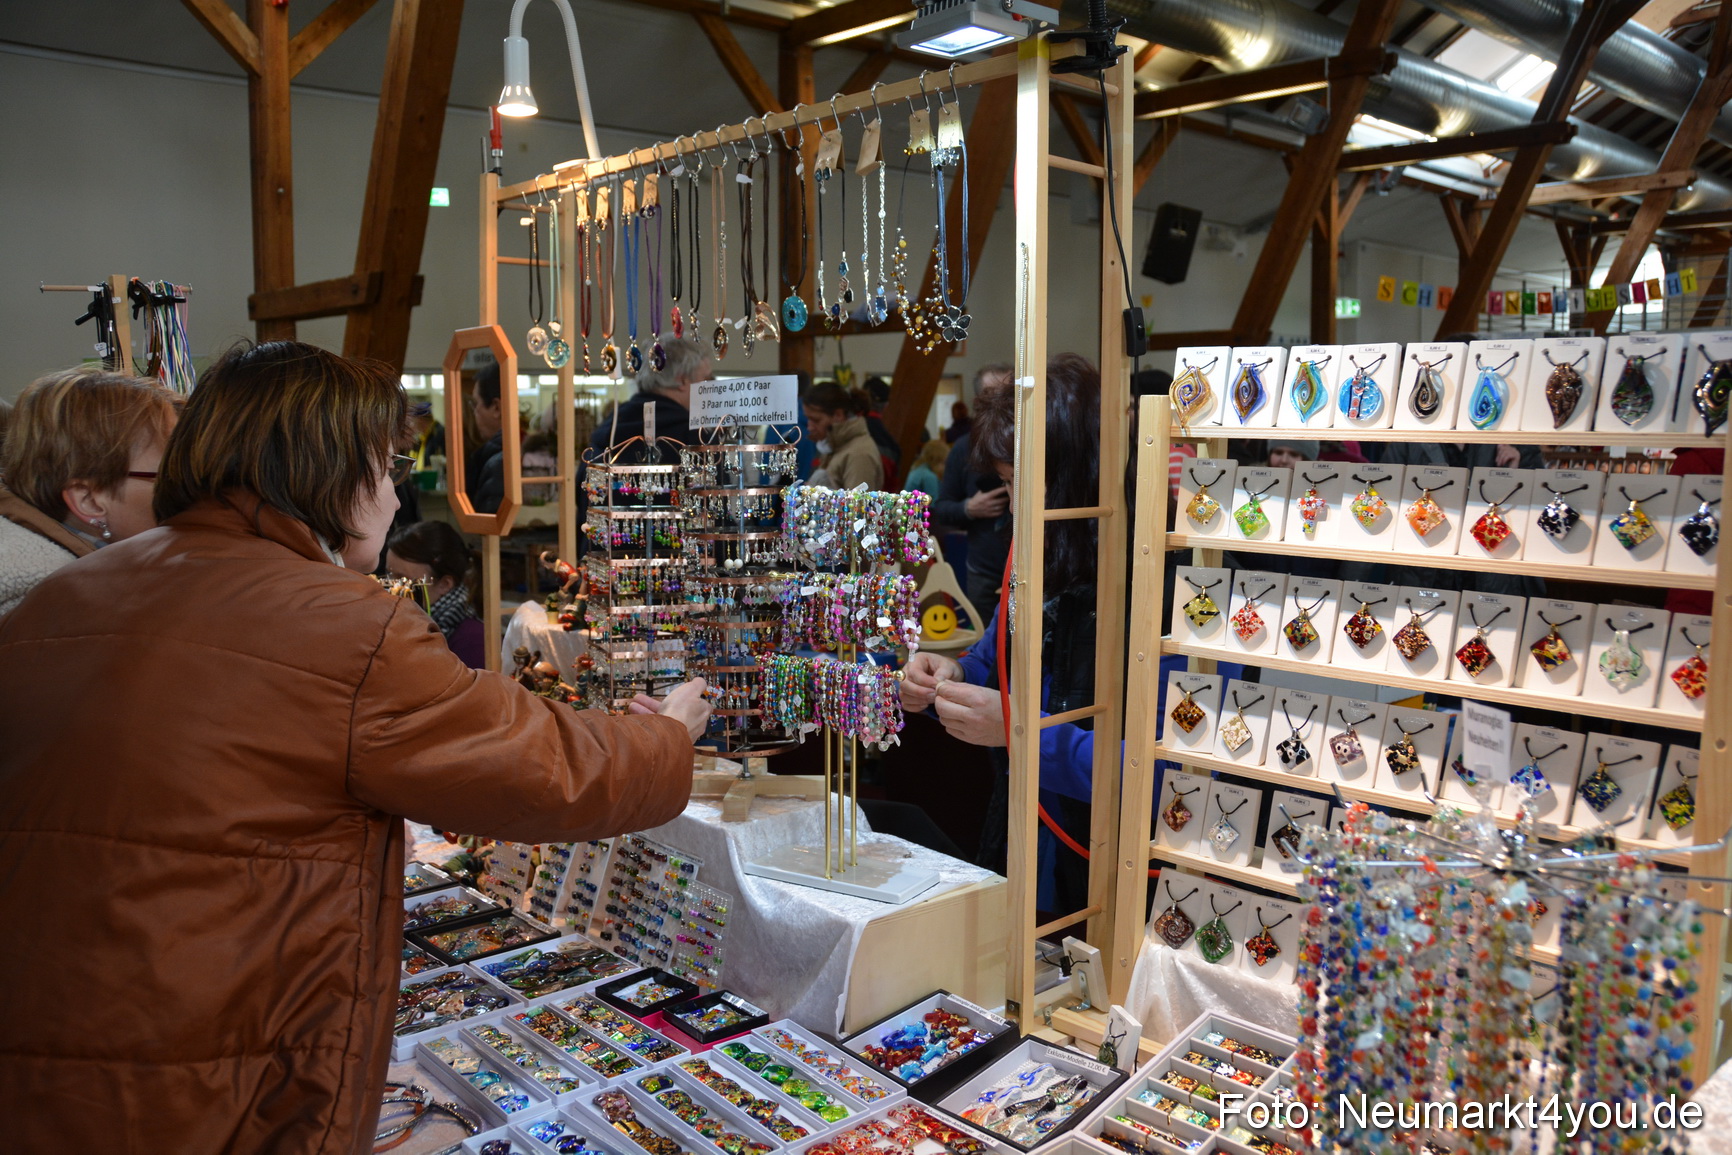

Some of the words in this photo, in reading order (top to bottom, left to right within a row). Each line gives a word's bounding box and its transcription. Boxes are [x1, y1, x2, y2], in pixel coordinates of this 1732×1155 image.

[1587, 273, 1694, 310] GESUCHT
[698, 383, 727, 395] Ohrringe
[728, 382, 744, 392] 4,00
[747, 381, 752, 390] €
[754, 381, 771, 390] Paar
[702, 401, 706, 410] 3
[707, 400, 722, 410] Paar
[724, 400, 736, 408] nur
[740, 397, 760, 408] 10,00
[763, 396, 768, 406] €
[700, 415, 730, 426] Ohrringe
[732, 413, 748, 423] sind
[752, 411, 788, 422] nickelfrei
